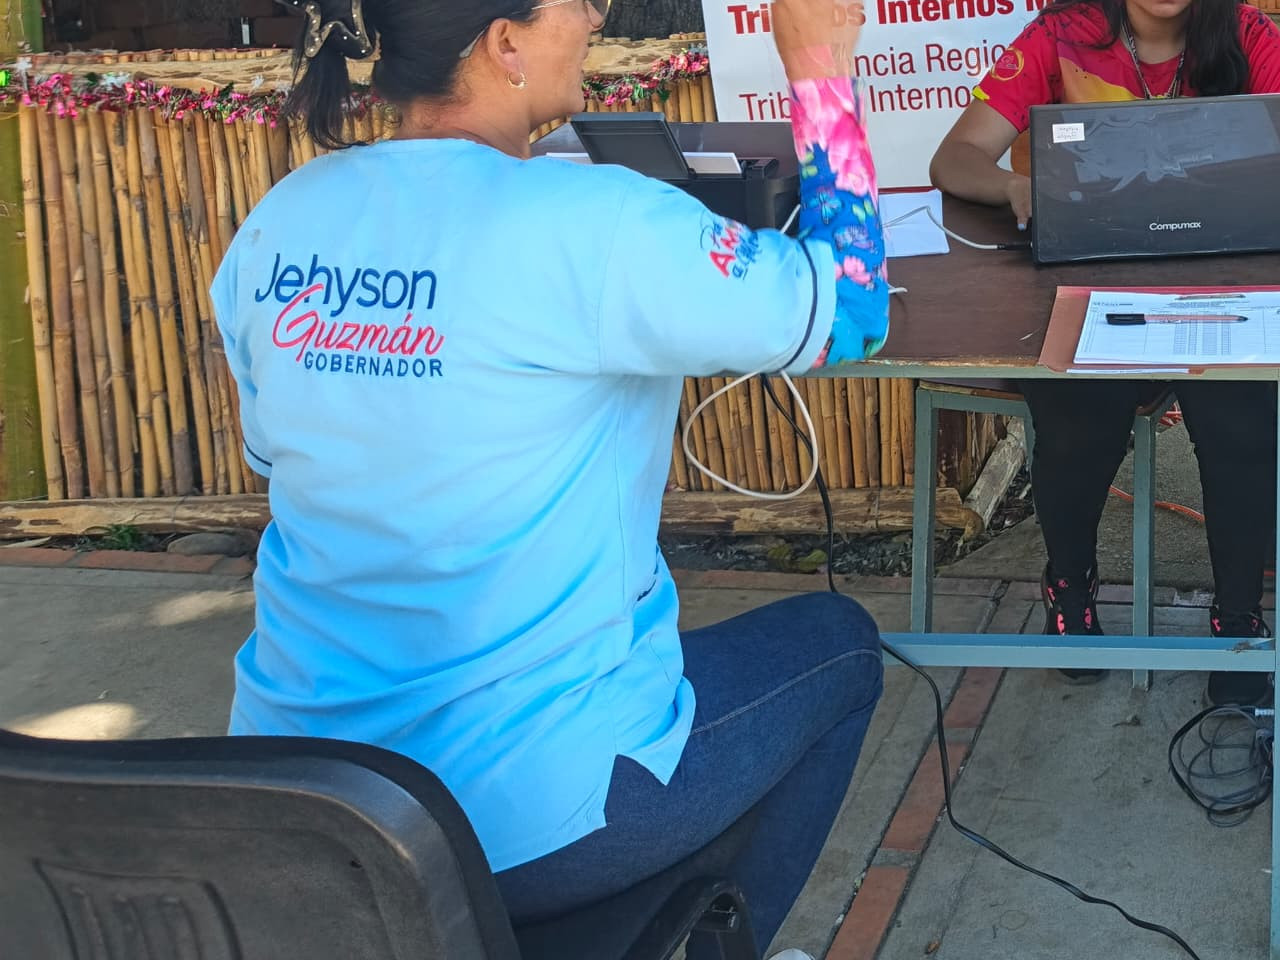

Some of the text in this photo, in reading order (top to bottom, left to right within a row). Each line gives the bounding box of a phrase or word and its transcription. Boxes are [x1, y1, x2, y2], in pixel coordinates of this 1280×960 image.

[1149, 221, 1201, 231] Compumax
[255, 252, 437, 317] Jehyson
[272, 283, 445, 362] Guzmán
[304, 351, 444, 378] GOBERNADOR
